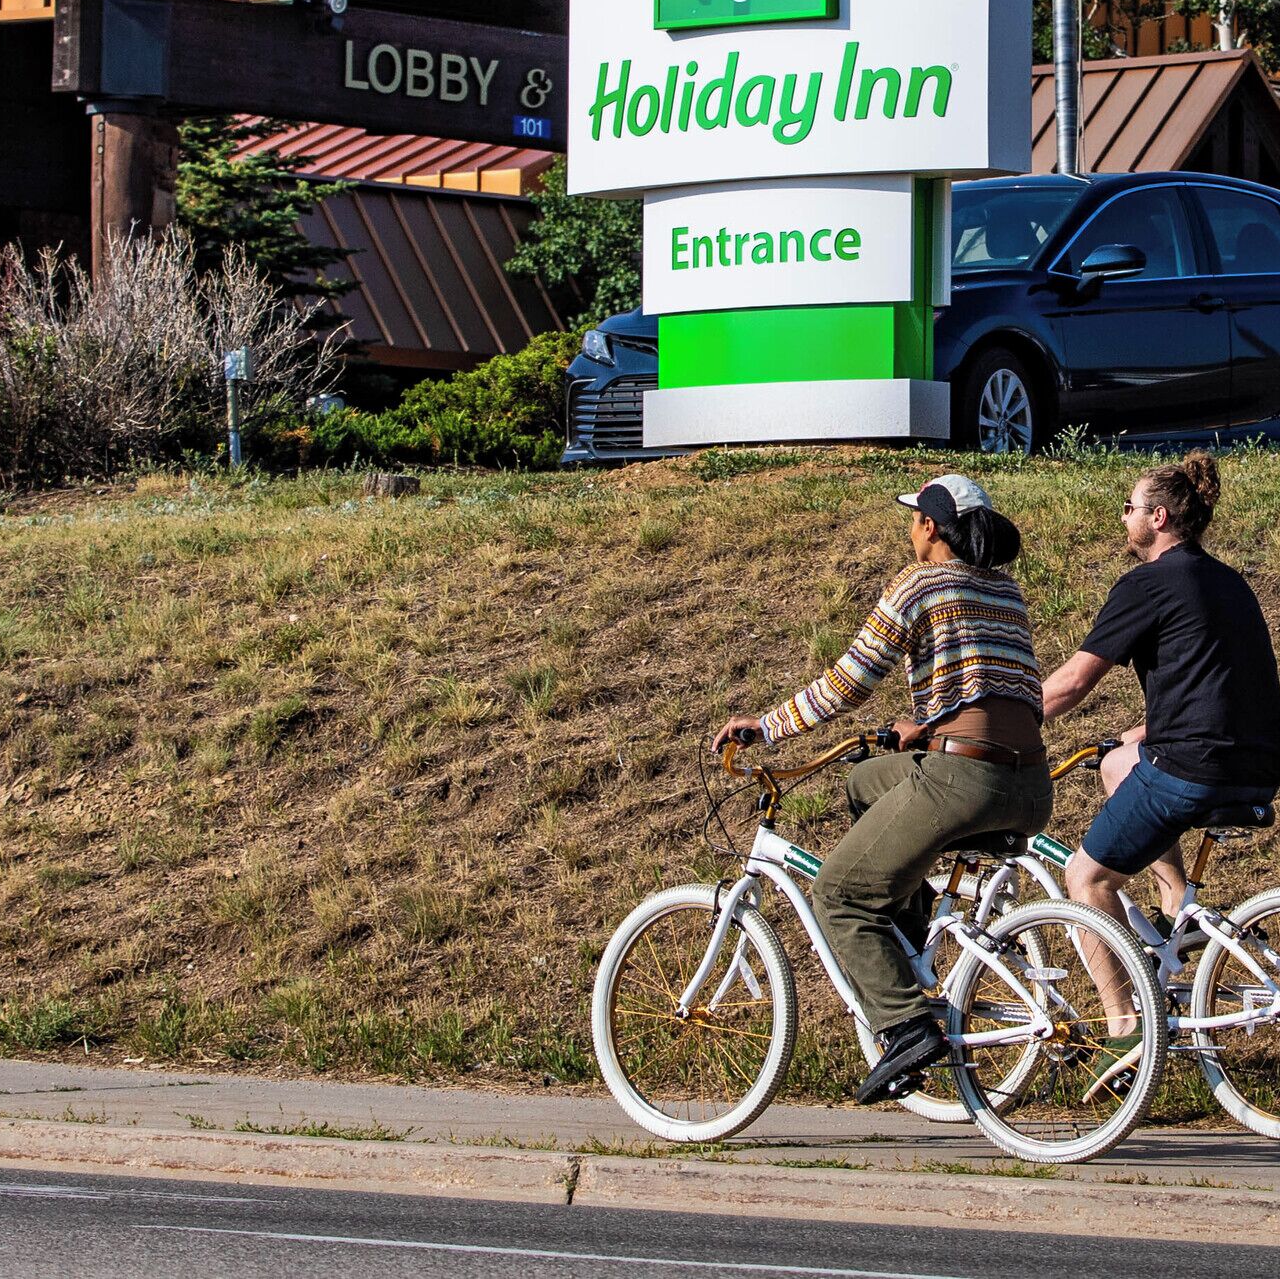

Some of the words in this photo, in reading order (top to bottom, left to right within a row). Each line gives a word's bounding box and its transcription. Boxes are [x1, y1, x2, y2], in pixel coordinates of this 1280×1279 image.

[345, 40, 499, 105] LOBBY
[521, 69, 553, 108] &
[589, 51, 823, 145] Holiday
[834, 42, 952, 122] Inn
[521, 118, 543, 136] 101
[672, 226, 861, 270] Entrance
